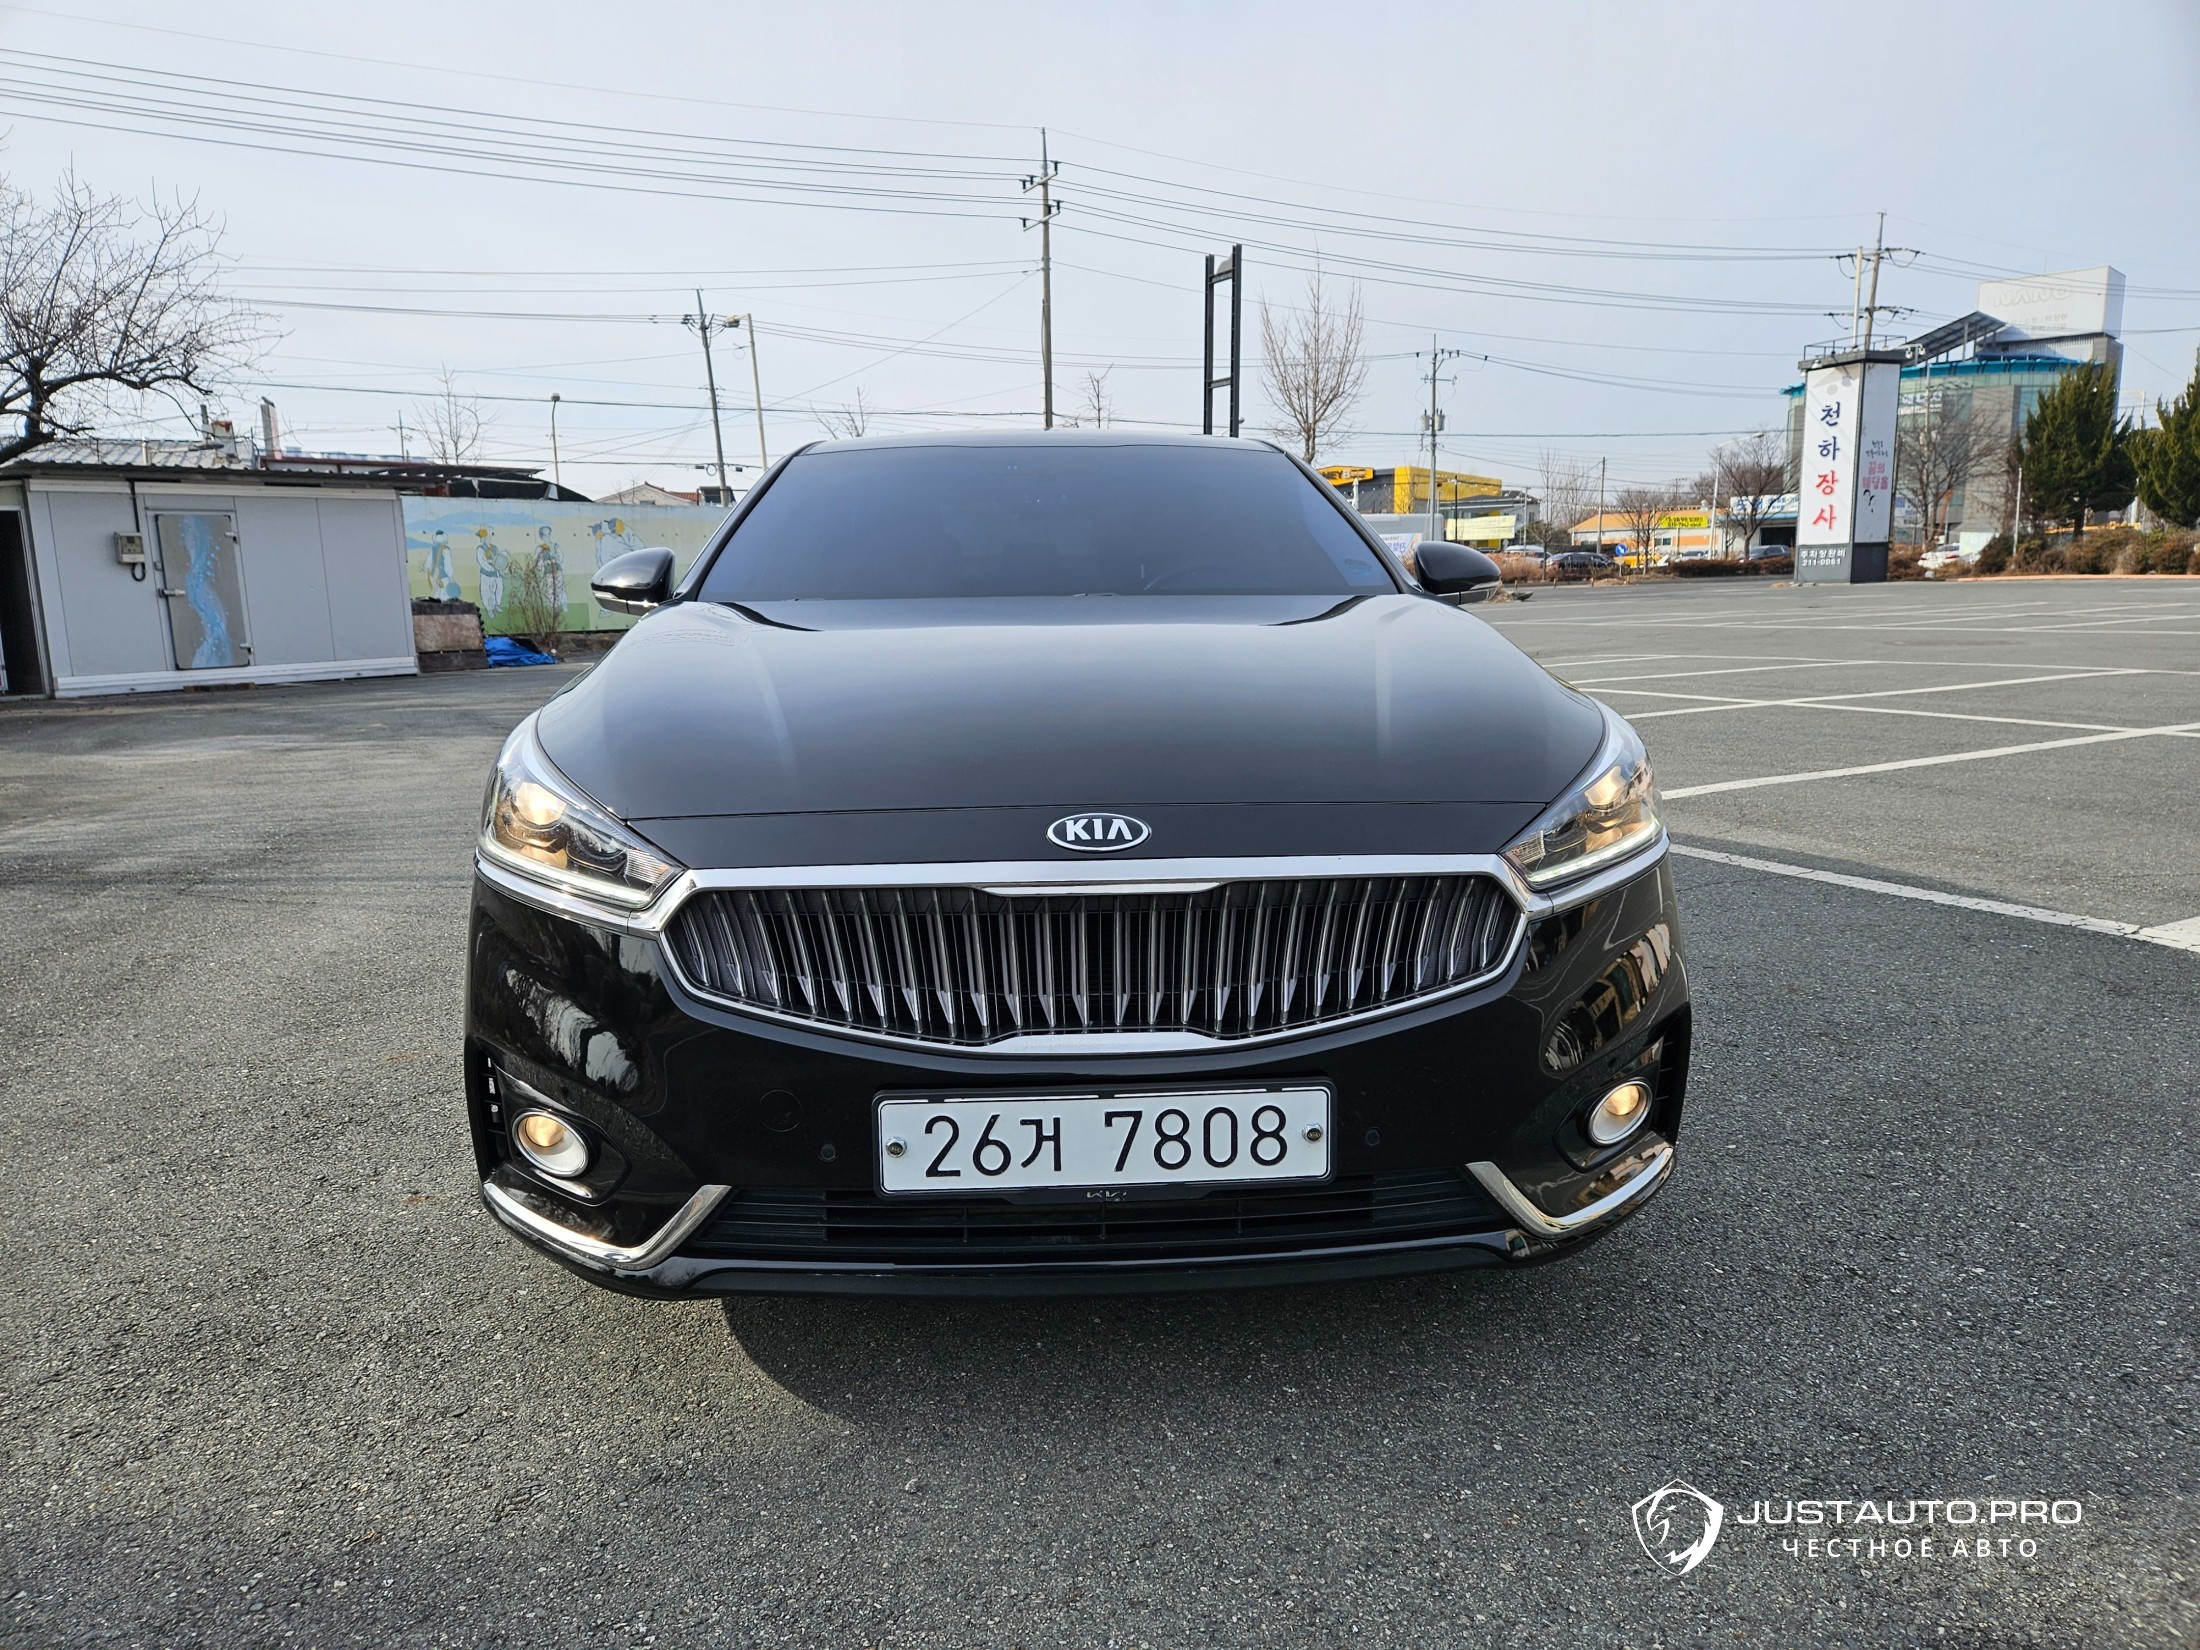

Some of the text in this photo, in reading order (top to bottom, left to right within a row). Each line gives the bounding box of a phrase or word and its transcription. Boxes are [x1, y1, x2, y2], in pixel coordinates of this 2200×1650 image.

[1812, 401, 1841, 530] 천하장사
[1064, 818, 1133, 841] KIA
[923, 1104, 1289, 1178] 26거 7808
